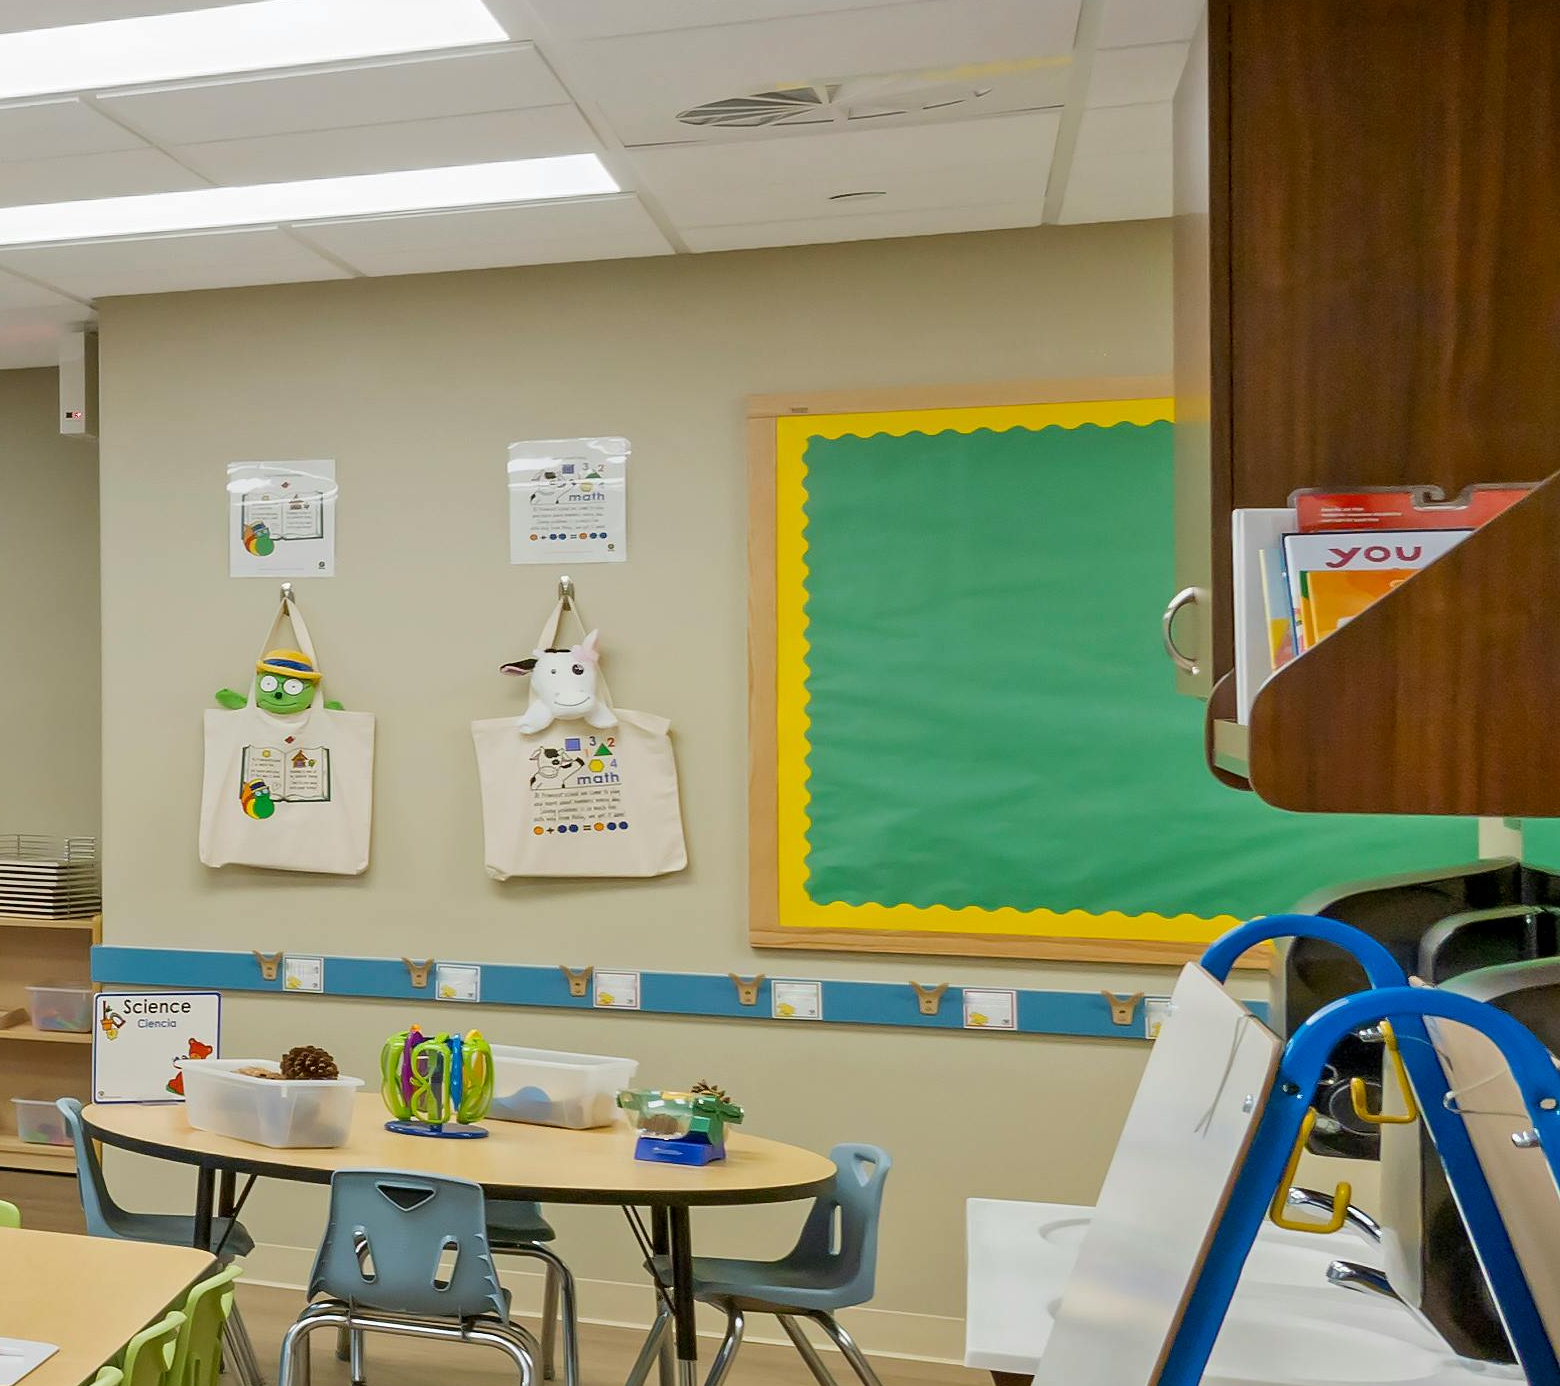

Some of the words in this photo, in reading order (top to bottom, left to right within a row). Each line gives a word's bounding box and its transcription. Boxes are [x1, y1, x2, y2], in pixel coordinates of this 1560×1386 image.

[569, 493, 605, 502] math
[1325, 546, 1423, 568] you
[589, 736, 597, 746] 3
[607, 738, 615, 747] 2
[610, 759, 617, 767] 4
[577, 773, 619, 785] math
[123, 999, 191, 1015] Science
[137, 1018, 177, 1029] Ciencia
